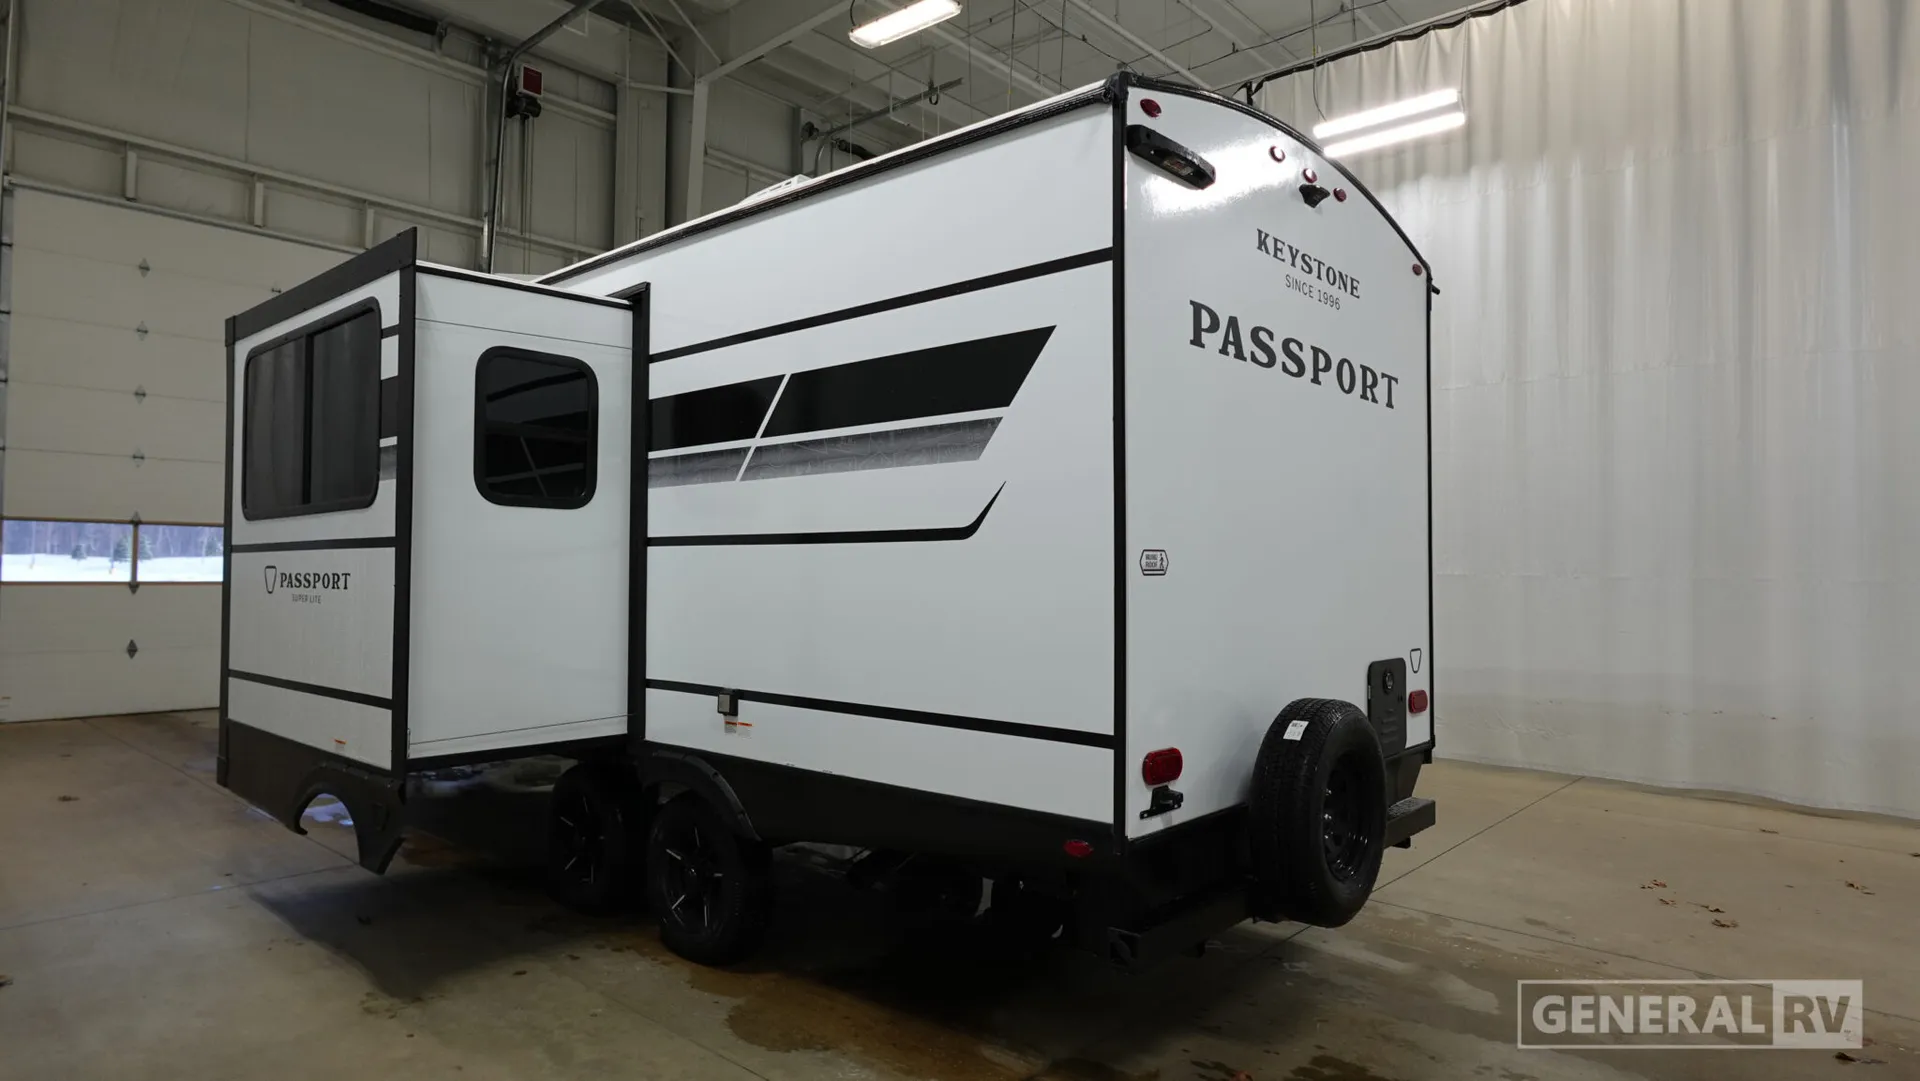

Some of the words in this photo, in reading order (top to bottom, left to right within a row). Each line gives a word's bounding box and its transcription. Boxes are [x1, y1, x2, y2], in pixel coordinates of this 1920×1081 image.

[1256, 228, 1360, 299] KEYSTONE
[1285, 274, 1314, 299] SINCE
[1317, 288, 1341, 311] 1996
[1189, 299, 1399, 410] PASSPORT
[279, 572, 351, 590] PASSPORT
[309, 594, 322, 604] LITE
